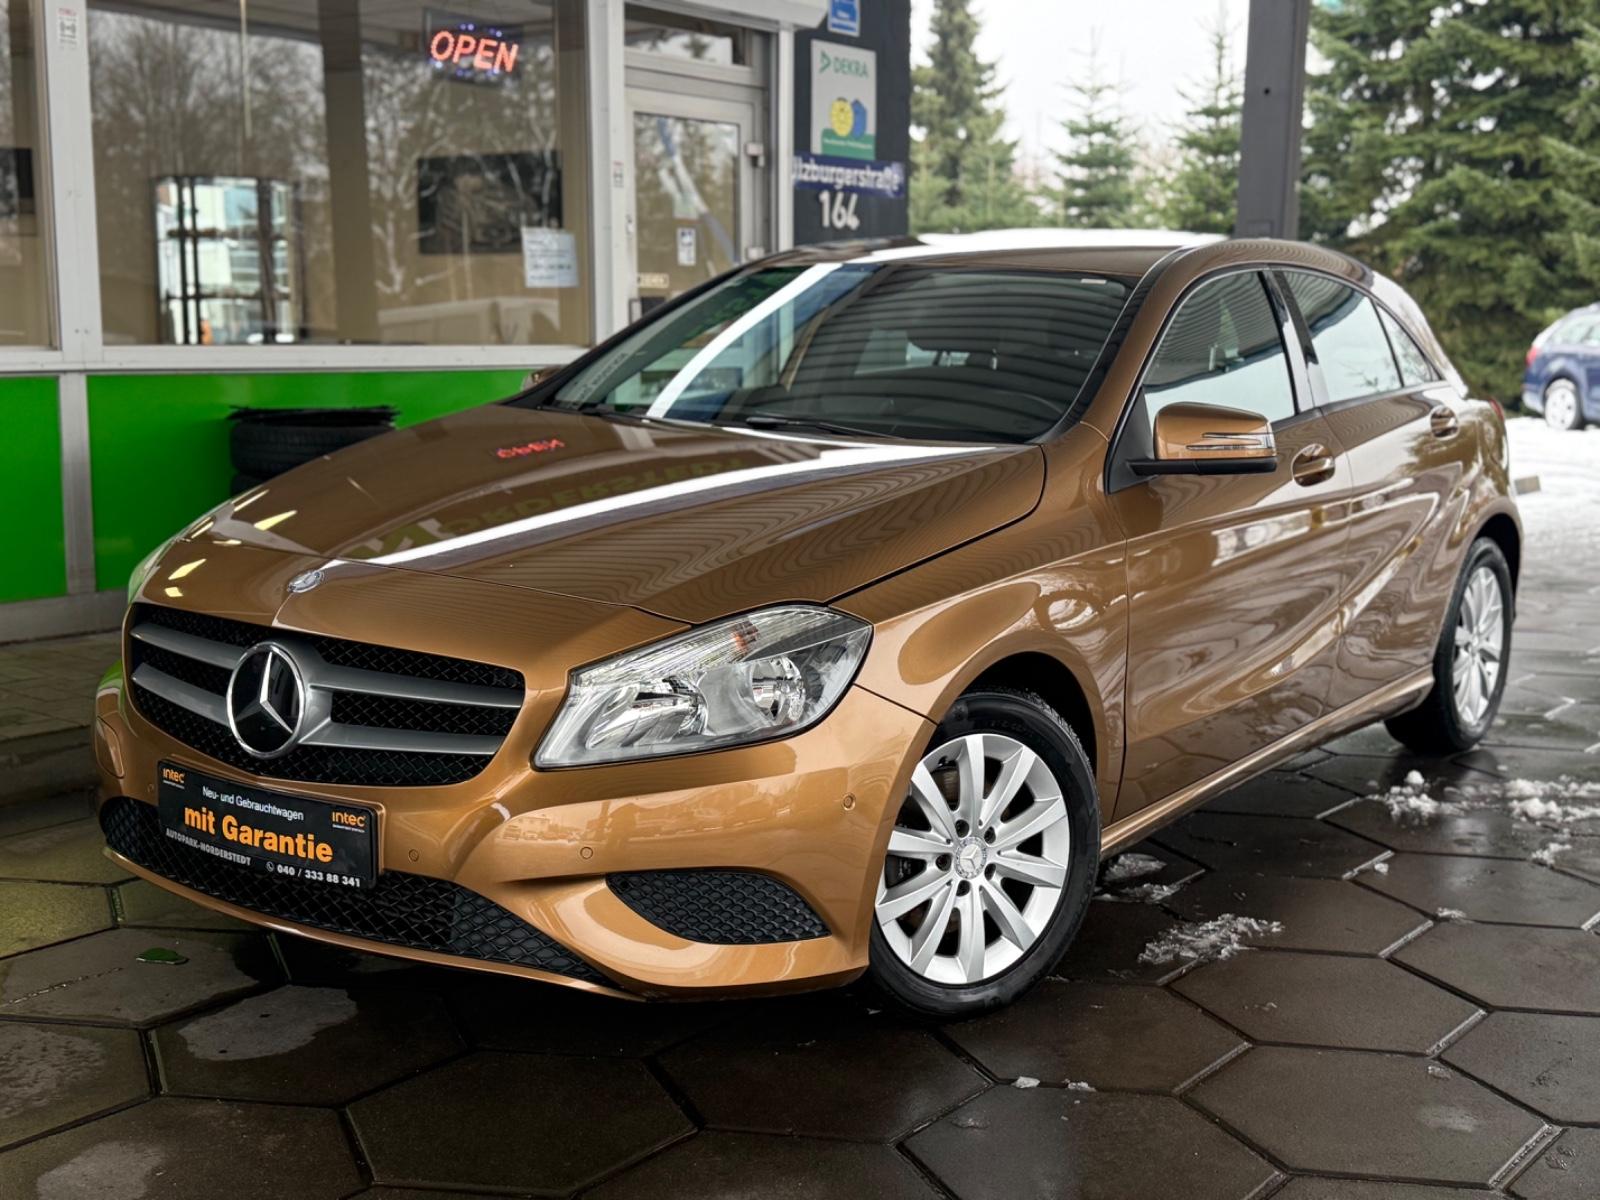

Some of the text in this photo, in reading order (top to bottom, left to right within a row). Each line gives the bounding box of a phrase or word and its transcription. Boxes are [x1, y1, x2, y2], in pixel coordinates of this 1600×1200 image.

[430, 30, 519, 73] OPEN
[833, 56, 869, 78] DEKRA
[819, 190, 860, 230] 164
[202, 785, 304, 821] Neu- und Gebrauchtwagen
[332, 811, 366, 828] intec
[165, 827, 252, 866] AUTOPARK-NORDERSTEDT
[184, 806, 334, 864] mit Garantie
[276, 863, 296, 877] 040
[304, 869, 324, 881] 333
[326, 873, 340, 885] 88
[341, 875, 361, 888] 341
